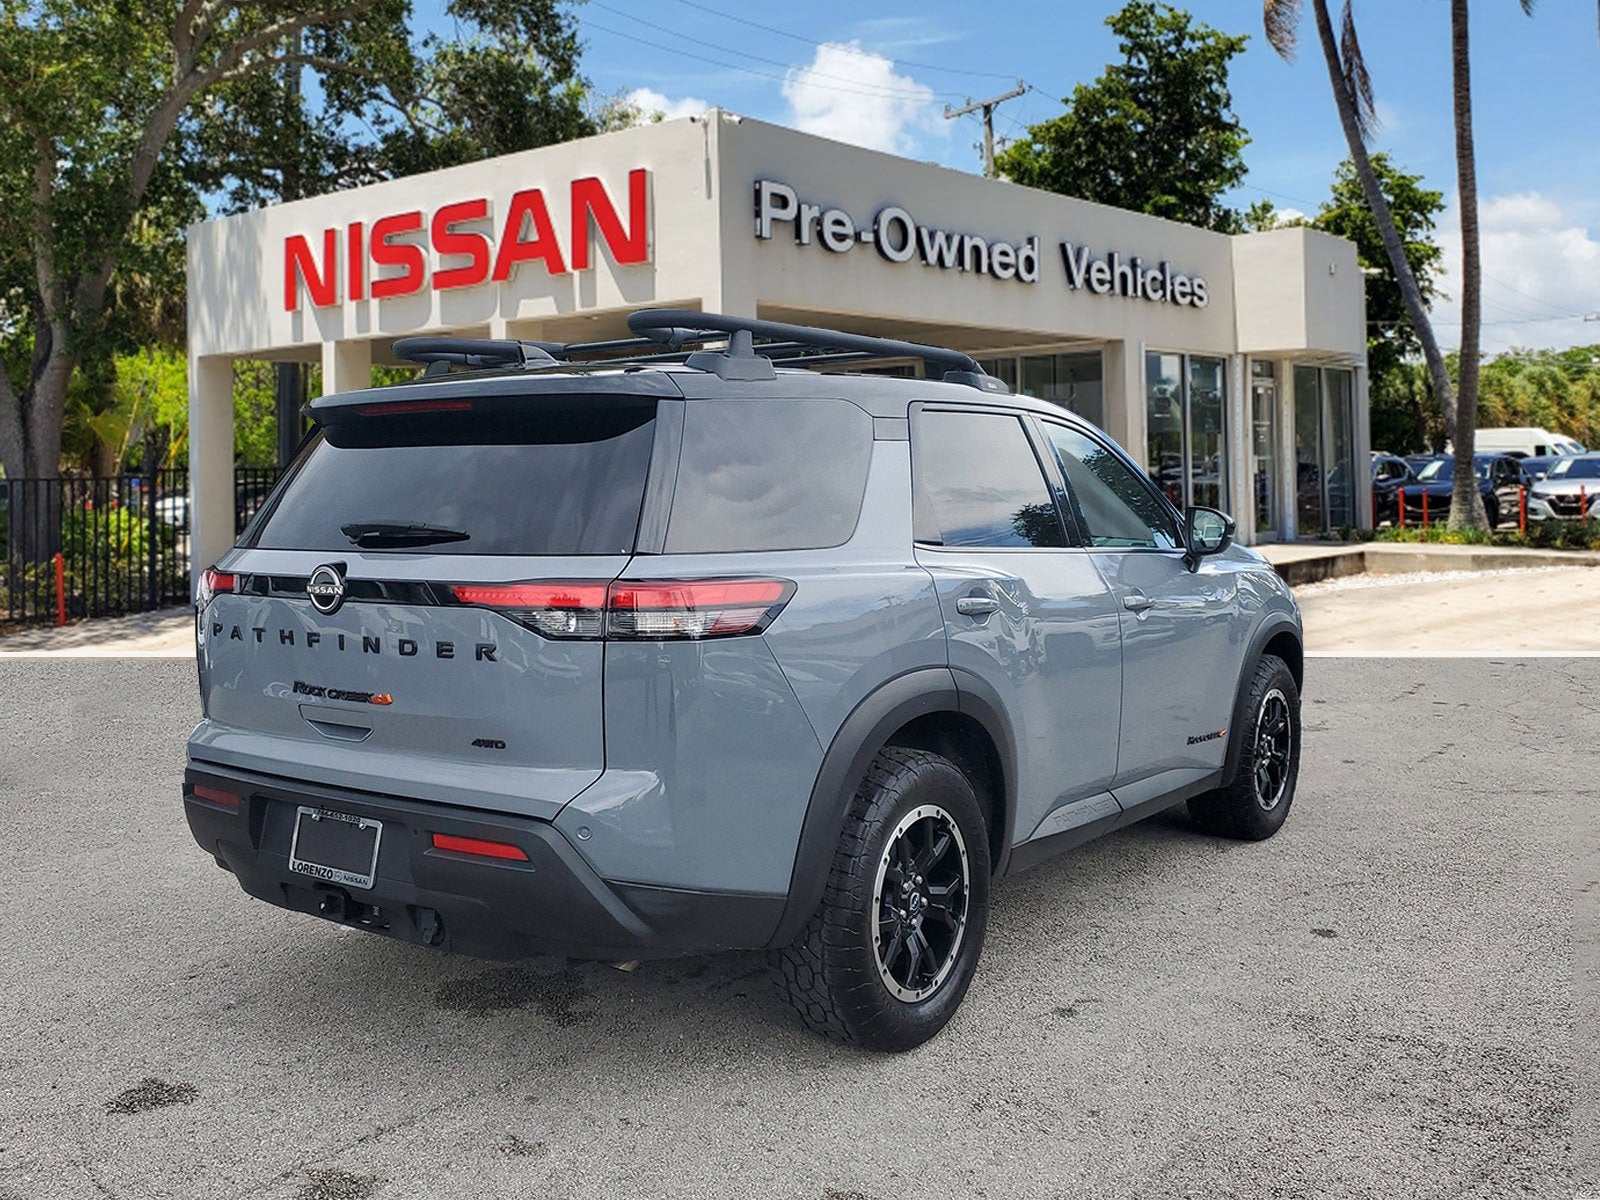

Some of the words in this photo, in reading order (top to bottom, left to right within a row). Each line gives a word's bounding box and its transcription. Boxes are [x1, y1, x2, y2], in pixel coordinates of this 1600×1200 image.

[284, 168, 649, 312] NISSAN
[754, 179, 1040, 284] Pre-Owned
[1060, 241, 1209, 309] Vehicles
[306, 585, 344, 596] NISSAN
[213, 622, 498, 662] PATHFINDER
[471, 736, 506, 749] 4WD
[292, 860, 334, 880] LORENZO
[343, 875, 369, 886] NISSAN
